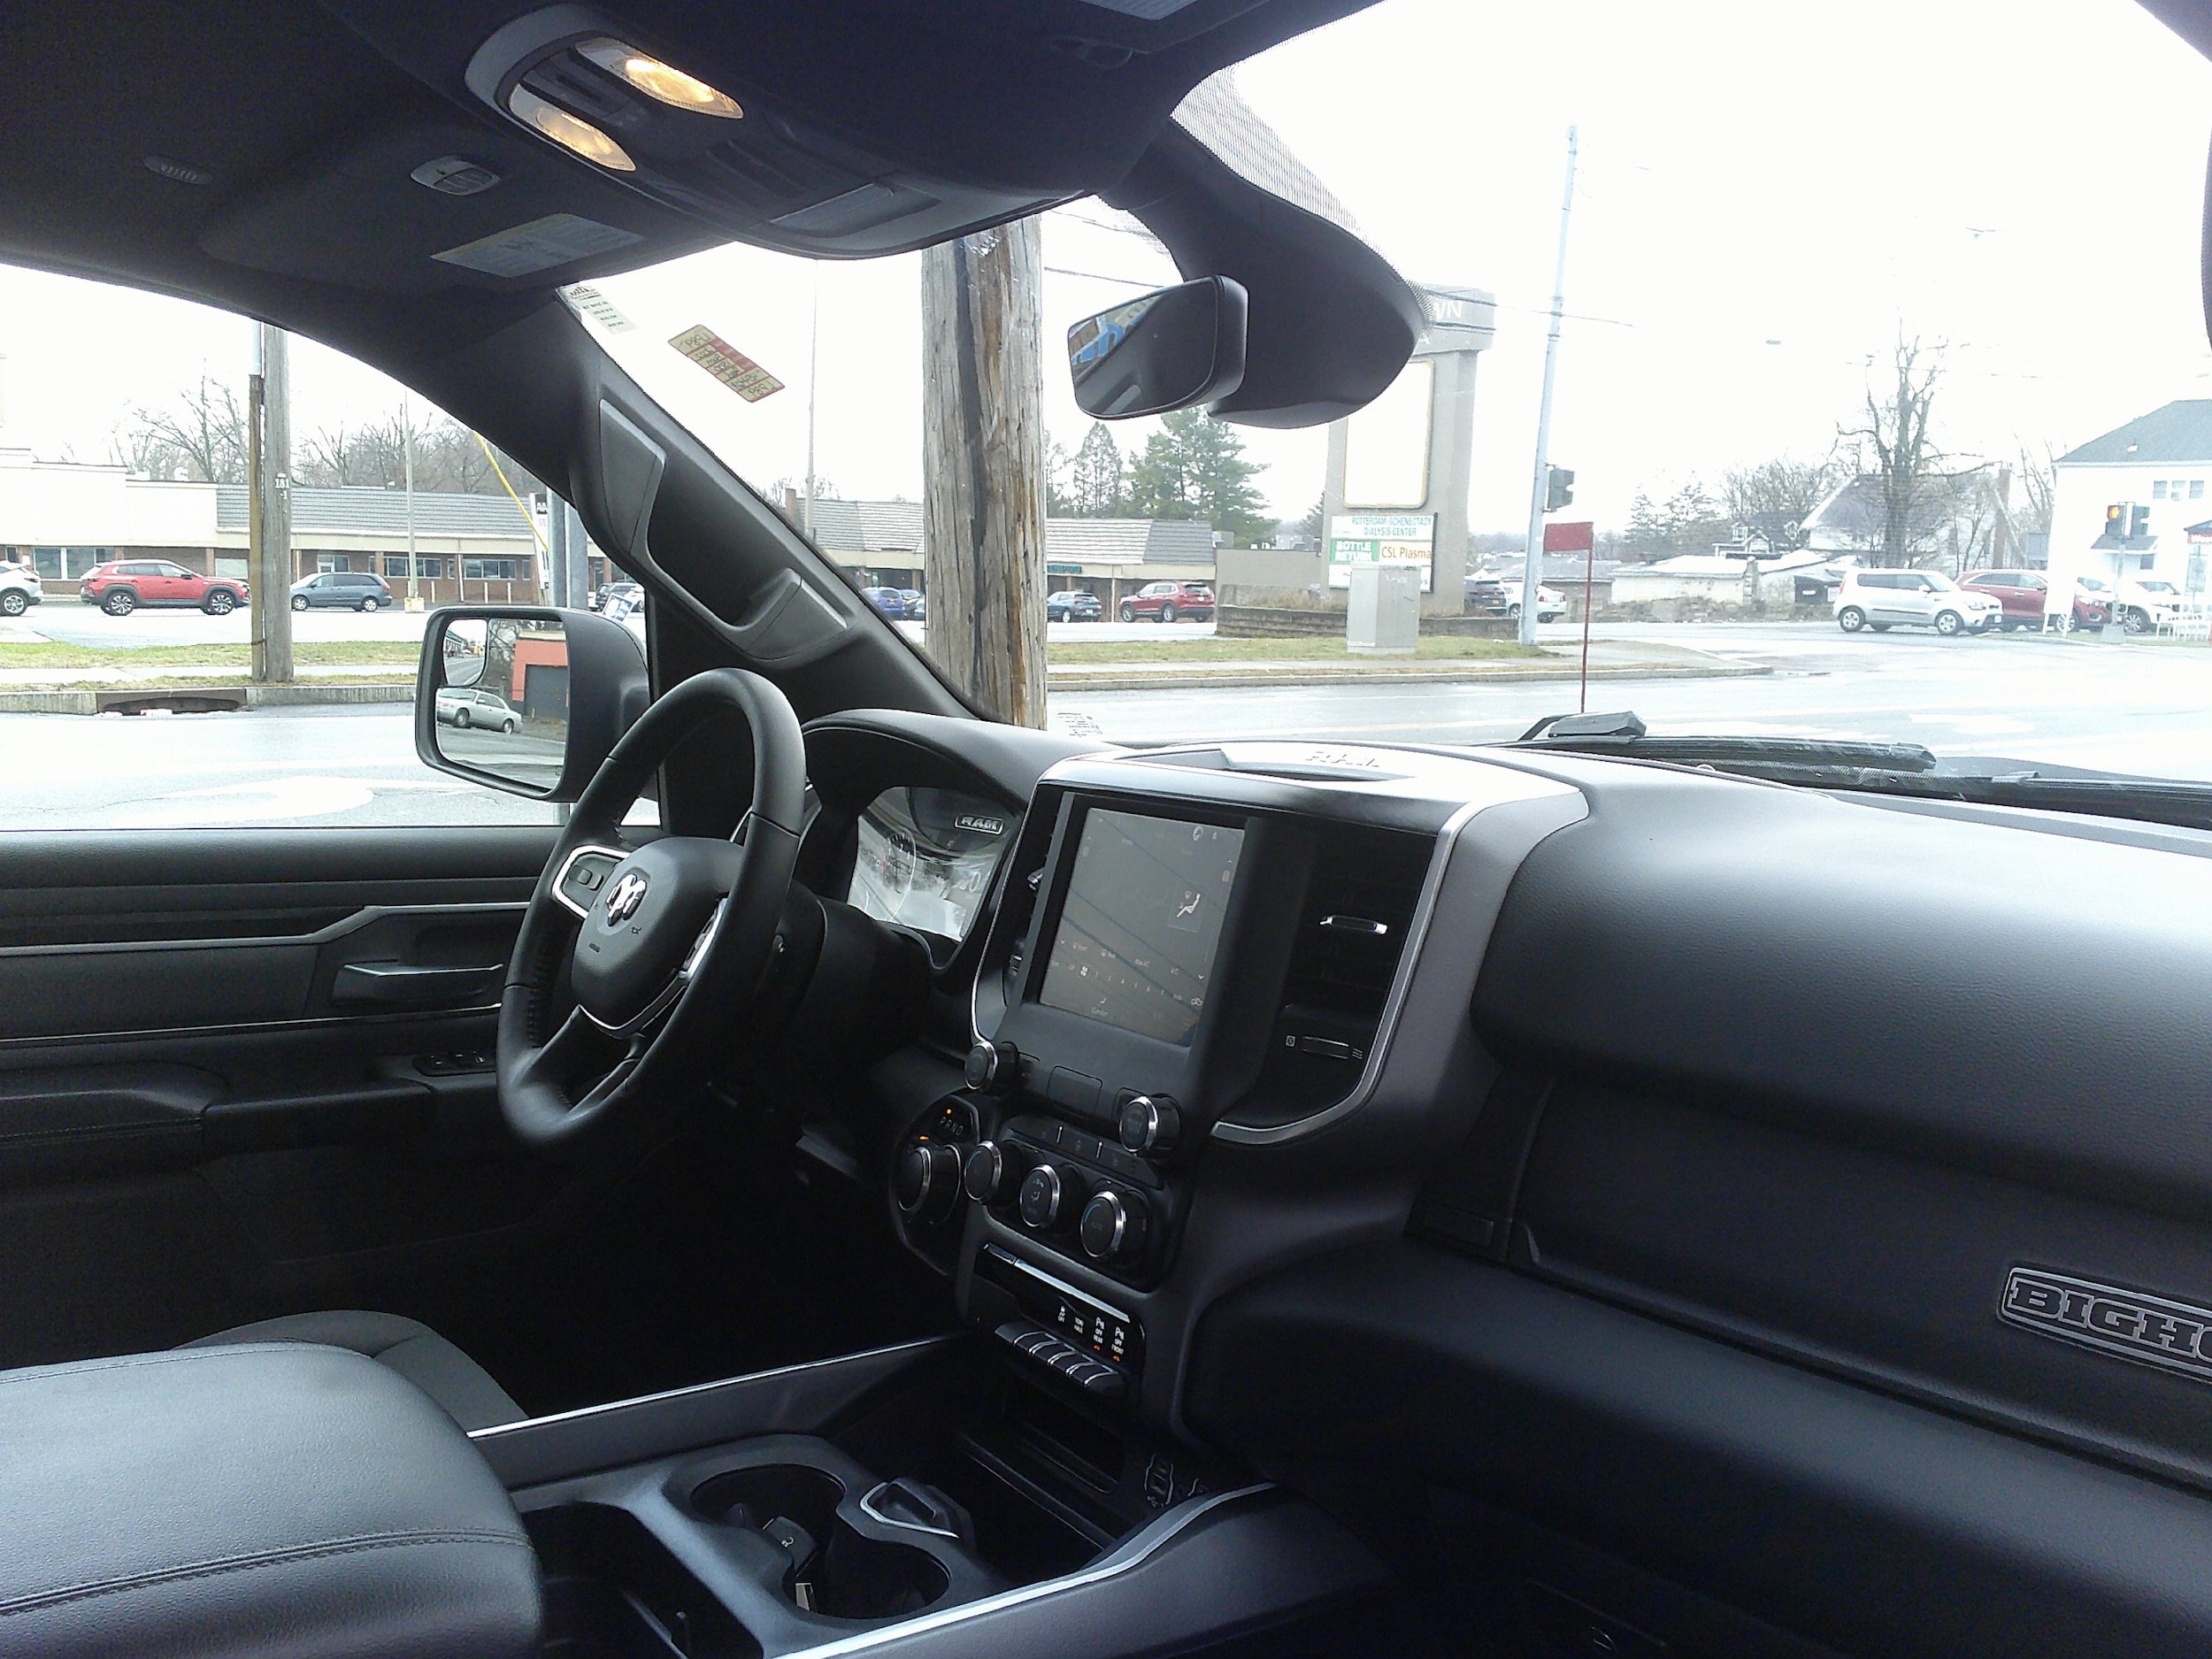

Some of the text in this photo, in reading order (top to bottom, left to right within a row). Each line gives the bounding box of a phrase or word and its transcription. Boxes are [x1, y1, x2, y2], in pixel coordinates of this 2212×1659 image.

[275, 478, 289, 488] 181
[1363, 526, 1417, 536] DIALYSIS CENTER
[1336, 541, 1371, 551] BOTTLE
[1381, 547, 1432, 559] CSL Plasma
[961, 816, 1000, 831] RAM
